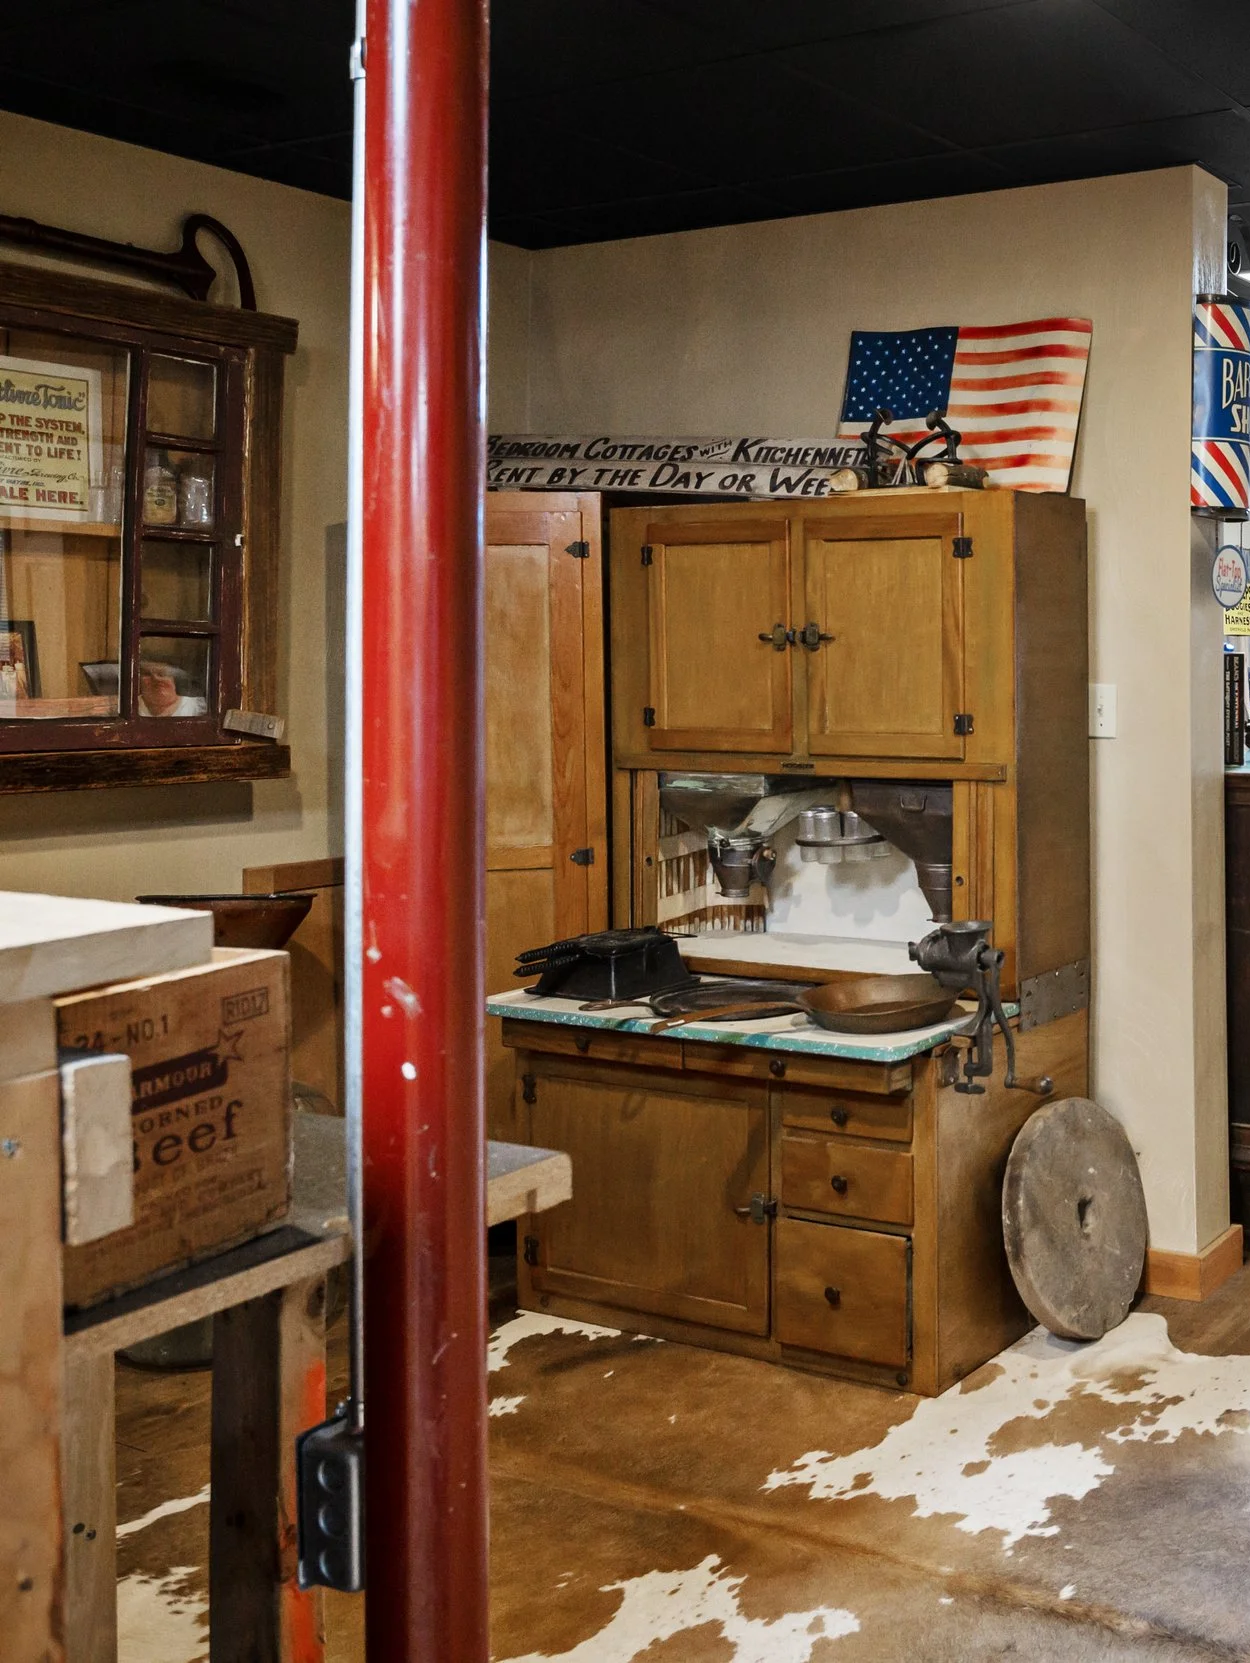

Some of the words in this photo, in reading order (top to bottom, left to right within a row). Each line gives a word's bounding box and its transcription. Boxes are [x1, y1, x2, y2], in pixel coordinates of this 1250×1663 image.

[8, 413, 33, 428] THE
[35, 416, 85, 435] SYSTEM,
[57, 435, 78, 447] AND
[583, 437, 699, 461] COTTAGES
[26, 444, 43, 458] TO
[47, 449, 82, 461] LIFE!
[487, 460, 544, 483] RENT
[547, 467, 589, 485] BY
[593, 468, 647, 486] THE
[648, 462, 715, 489] DAY
[718, 472, 757, 492] OR
[769, 468, 838, 496] WEE
[36, 488, 84, 505] HERE.
[138, 1096, 223, 1133] ORNED
